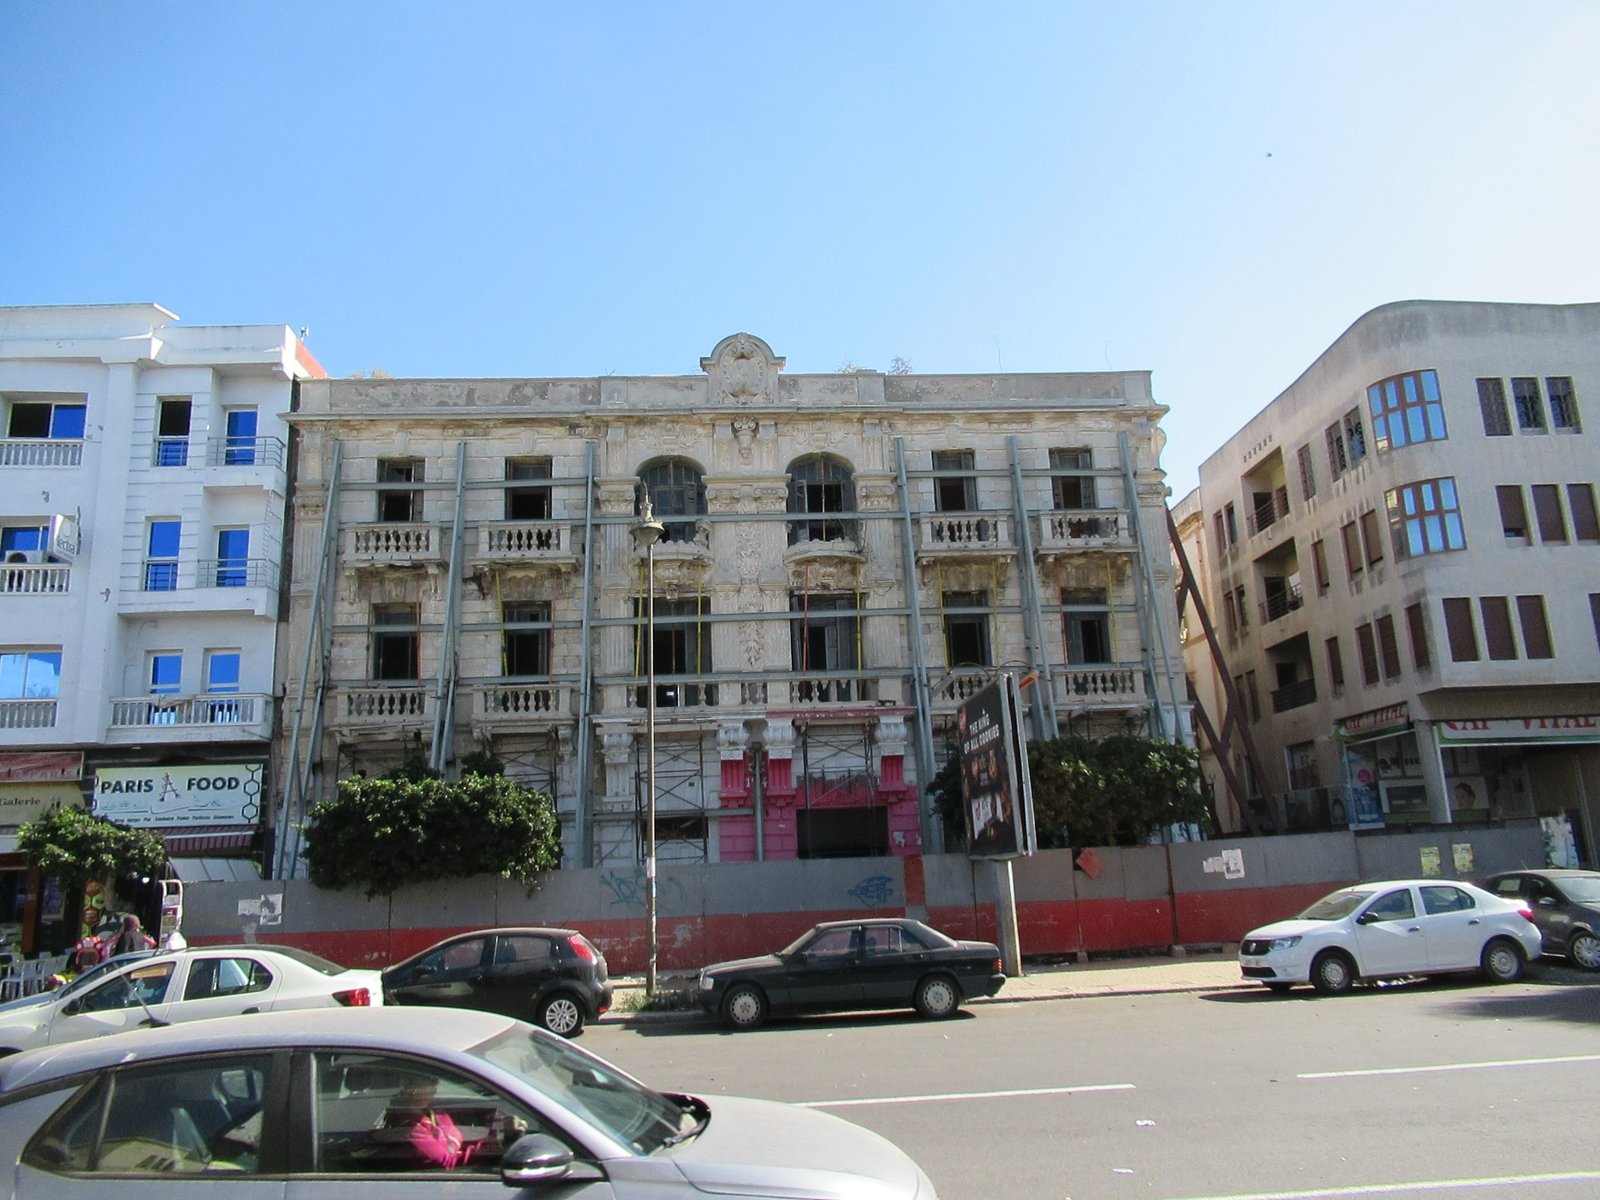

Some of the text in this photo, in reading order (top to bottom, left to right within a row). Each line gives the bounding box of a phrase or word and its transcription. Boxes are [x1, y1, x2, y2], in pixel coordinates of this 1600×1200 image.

[969, 721, 978, 737] THE
[101, 776, 240, 794] PARIS FOOD
